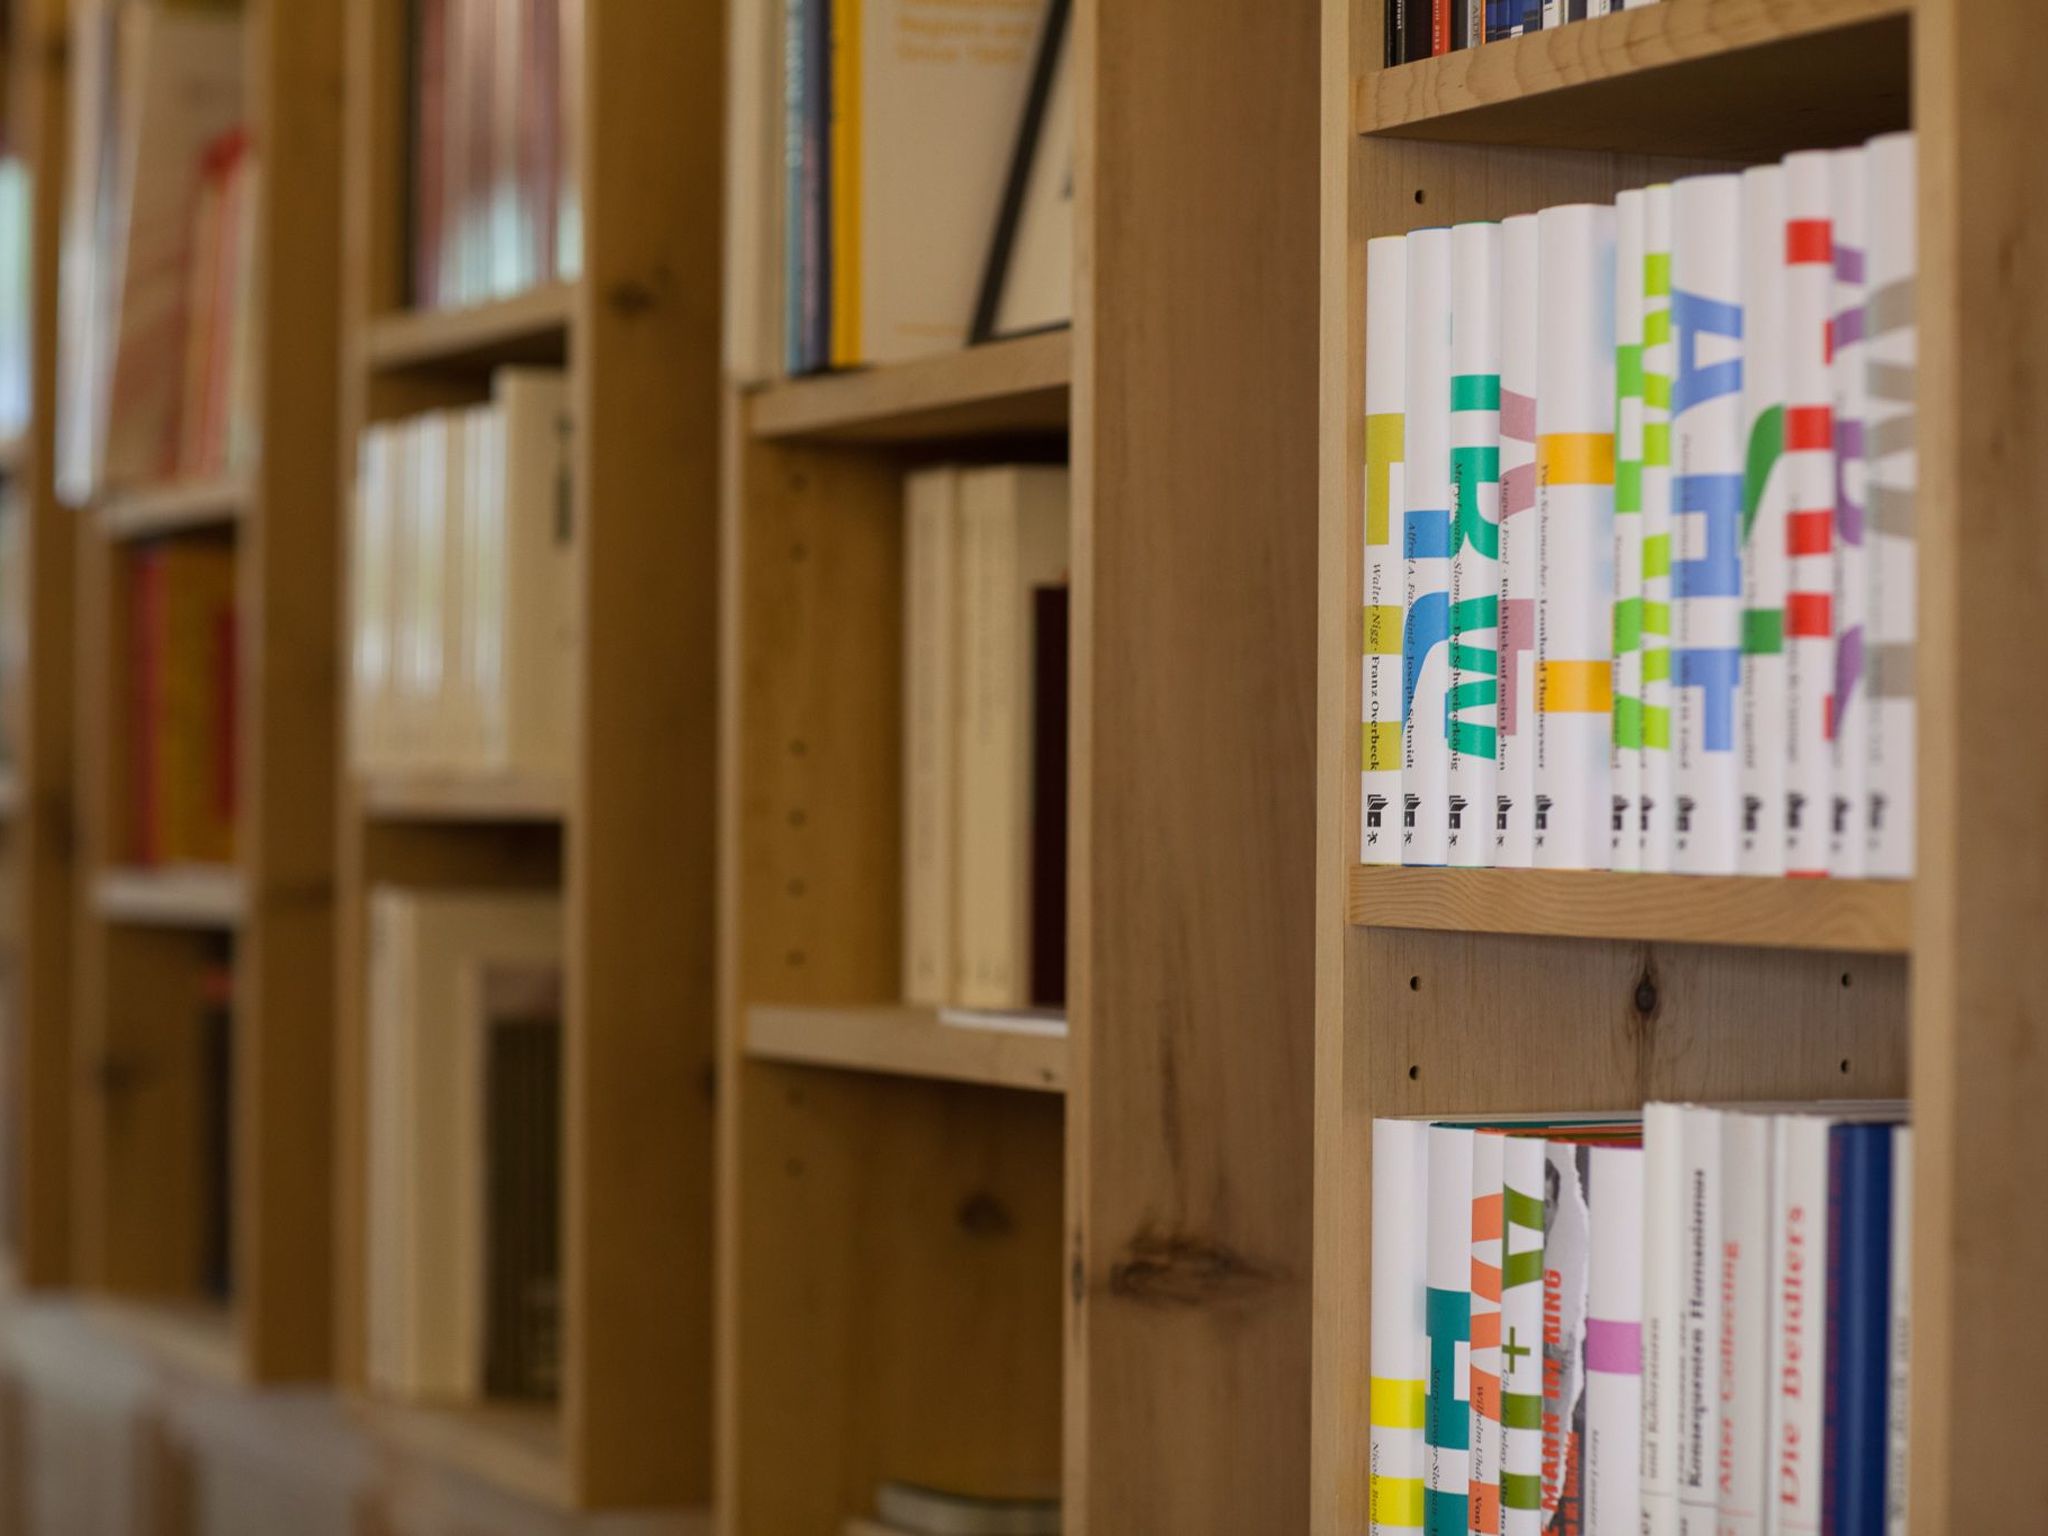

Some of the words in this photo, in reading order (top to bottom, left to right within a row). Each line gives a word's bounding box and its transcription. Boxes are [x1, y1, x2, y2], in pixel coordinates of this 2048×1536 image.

[1454, 463, 1462, 500] Mary
[1408, 522, 1416, 563] Alfred
[1372, 564, 1381, 610] Walter
[1370, 613, 1381, 645] Nigg
[1454, 626, 1462, 652] Der
[1371, 656, 1380, 697] Franz
[1406, 656, 1415, 705] Joseph
[1451, 656, 1462, 771] Schweizerkönig
[1500, 683, 1508, 721] mein
[1370, 701, 1380, 770] Overbeck
[1406, 708, 1415, 768] Schmidt
[1500, 725, 1508, 770] Leben
[1719, 1242, 1741, 1404] Collecting
[1779, 1206, 1805, 1401] Beidlers
[1541, 1357, 1560, 1399] IM
[1476, 1386, 1484, 1444] Wilhelm
[1540, 1412, 1560, 1514] MANN
[1778, 1423, 1801, 1507] Die
